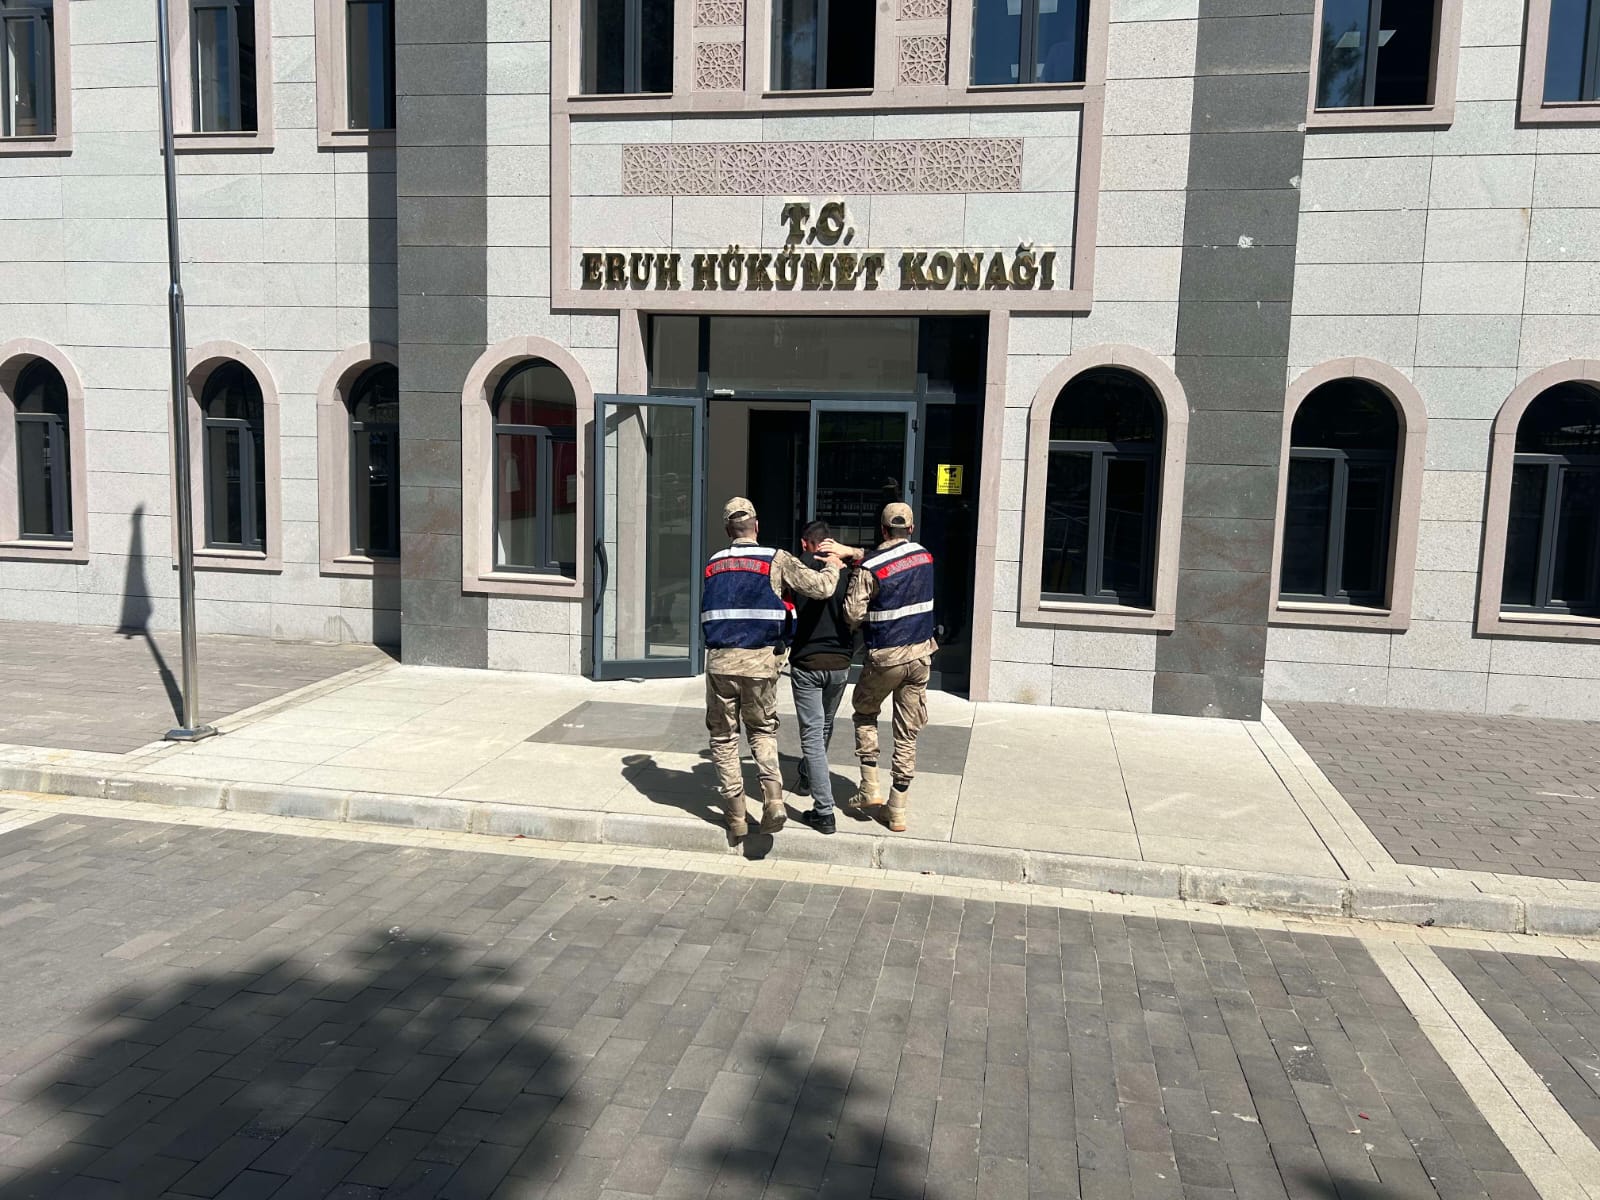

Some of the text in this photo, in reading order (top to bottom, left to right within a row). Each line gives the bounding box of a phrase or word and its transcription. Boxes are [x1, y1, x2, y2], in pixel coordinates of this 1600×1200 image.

[781, 203, 855, 245] T.C.
[580, 242, 1056, 290] ERUH HÜKÜMET KONAĞI
